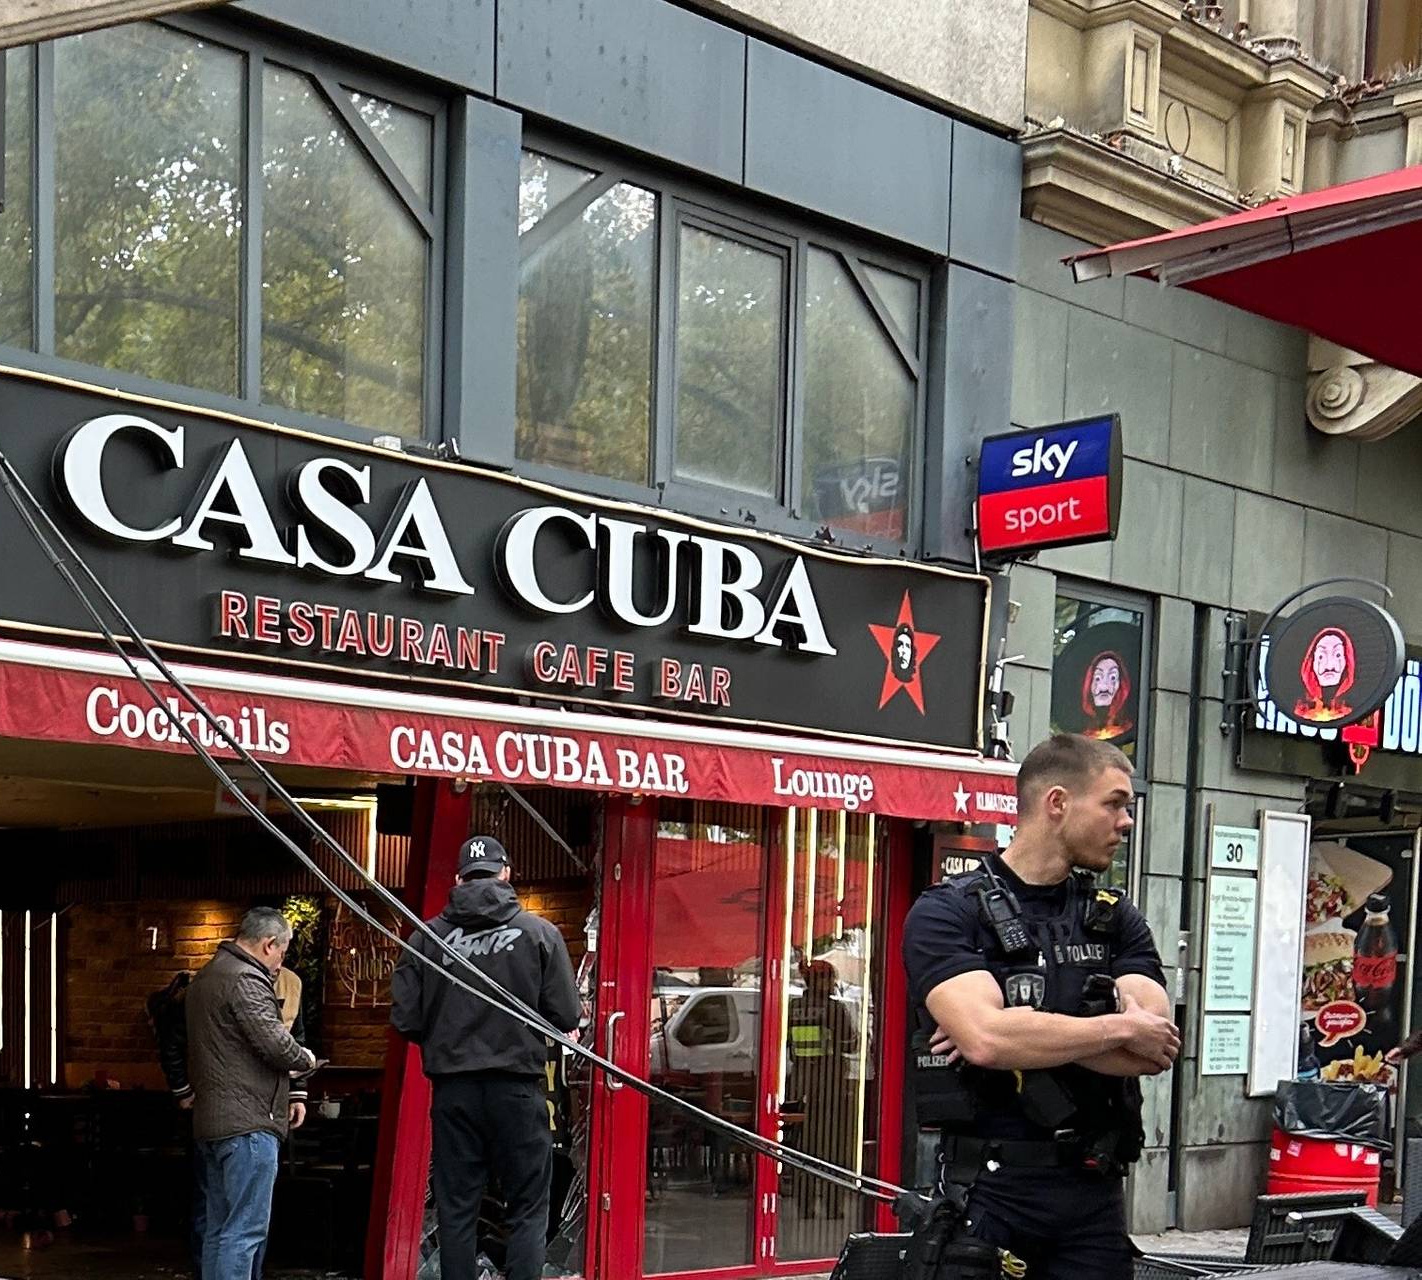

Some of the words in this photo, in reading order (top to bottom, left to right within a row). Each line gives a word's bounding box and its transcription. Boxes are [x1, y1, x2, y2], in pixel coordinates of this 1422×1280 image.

[1011, 437, 1079, 480] sky
[56, 413, 476, 596] CASA
[500, 505, 838, 657] CUBA
[1004, 496, 1082, 533] sport
[219, 589, 506, 675] RESTAURANT
[531, 640, 636, 694] CAFE
[658, 656, 732, 708] BAR
[85, 685, 291, 756] Cocktails
[389, 725, 493, 776] CASA
[494, 729, 614, 791] CUBA
[615, 747, 690, 794] BAR
[771, 757, 875, 811] Lounge
[1225, 842, 1244, 863] 30
